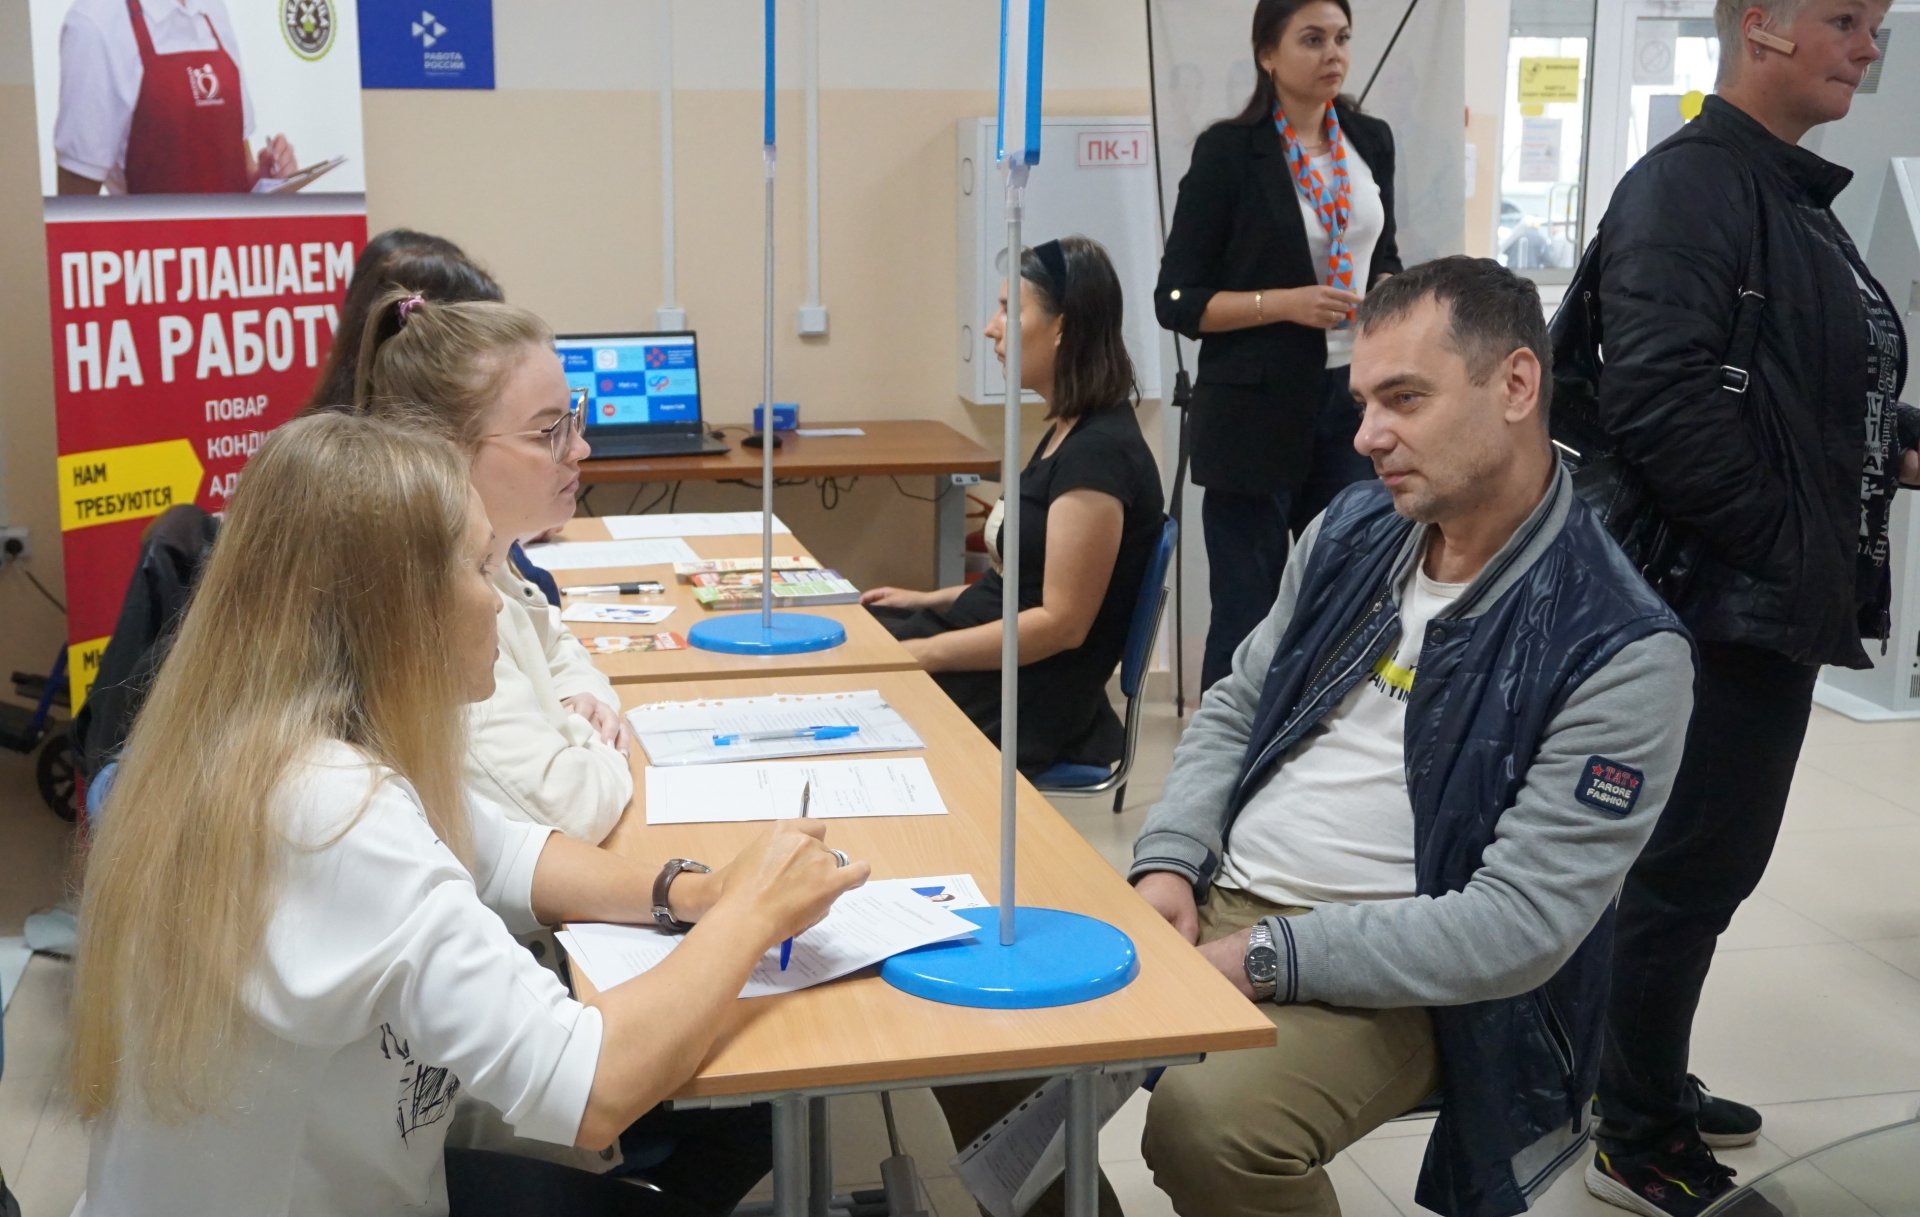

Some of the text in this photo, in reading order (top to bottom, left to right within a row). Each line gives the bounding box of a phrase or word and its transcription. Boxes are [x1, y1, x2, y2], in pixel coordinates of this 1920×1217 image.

[1087, 140, 1139, 160] ПК-1
[61, 241, 354, 309] ПРИГЛАШАЕМ
[65, 319, 144, 392] НА
[205, 395, 268, 422] ПОВАР
[73, 463, 107, 487] НАМ
[75, 487, 172, 520] ТРЕБУЮТСЯ
[1586, 788, 1628, 808] FASHION
[1593, 779, 1632, 799] TARORE
